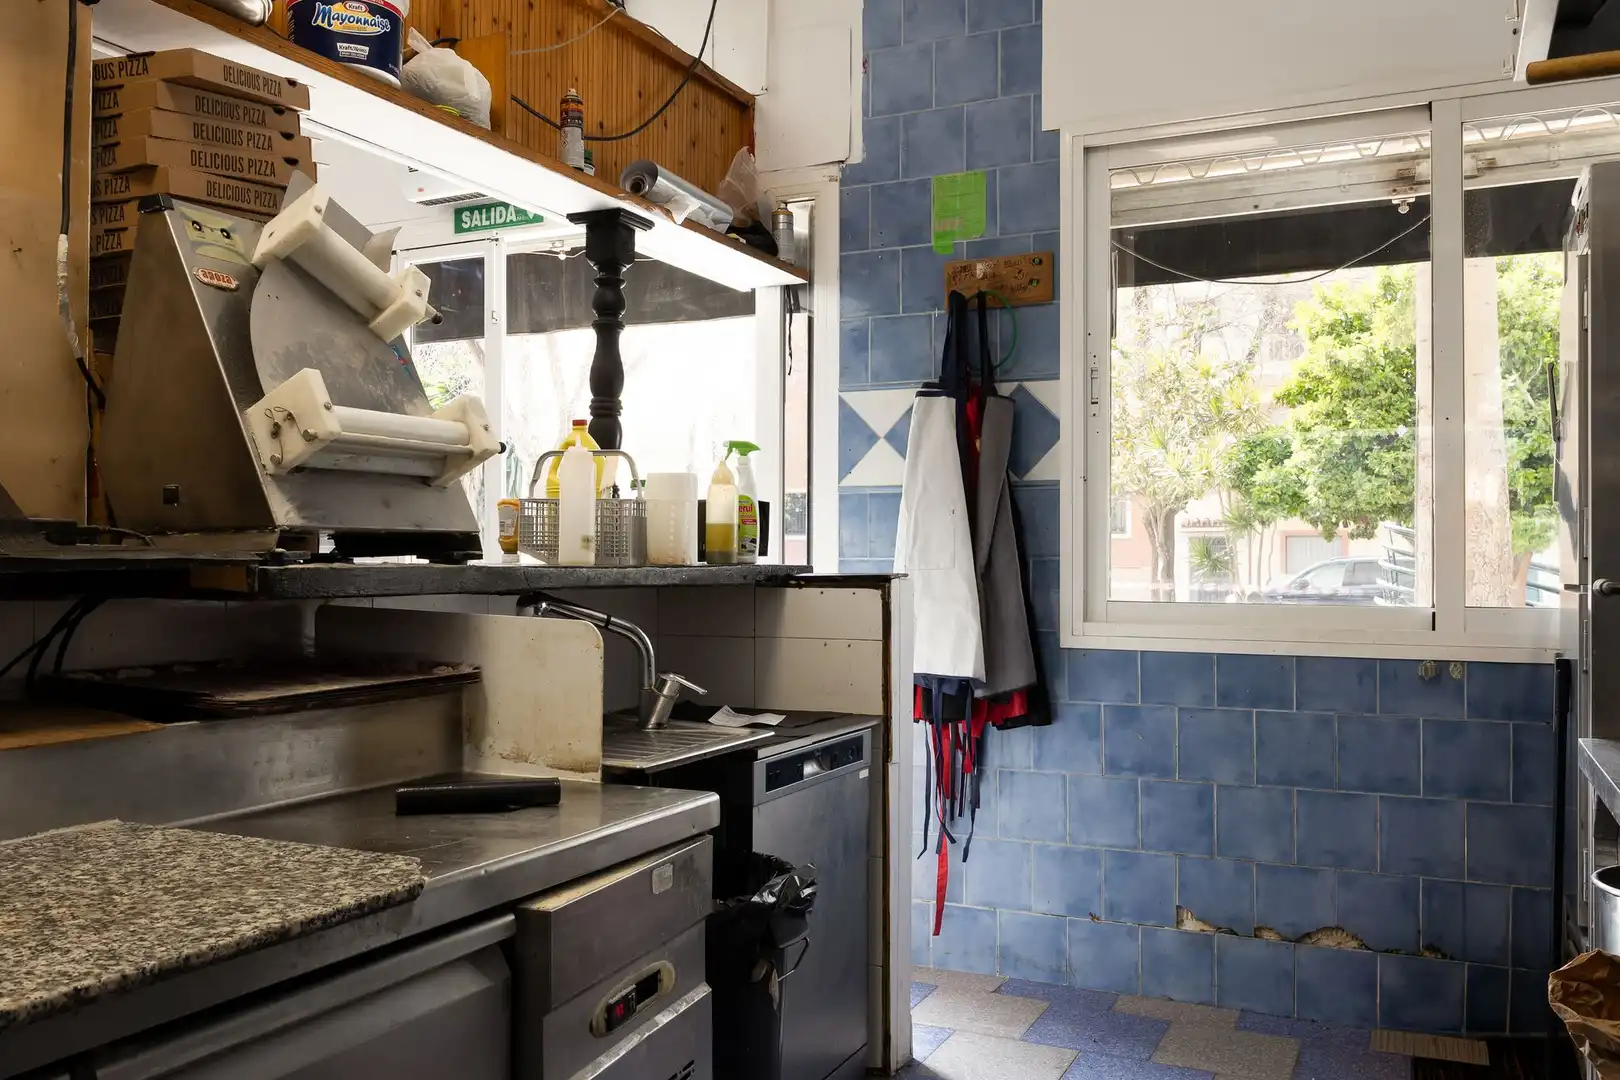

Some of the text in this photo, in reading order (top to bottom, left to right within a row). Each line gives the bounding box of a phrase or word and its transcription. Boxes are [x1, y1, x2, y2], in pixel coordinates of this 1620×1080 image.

[312, 2, 390, 31] Mayonnaise
[118, 57, 149, 78] PIZZA
[223, 64, 283, 98] DELICIOUS PIZZA
[98, 91, 119, 110] IZZA
[195, 95, 267, 127] DELICIOUS PIZZA
[193, 121, 273, 152] DELICIOUS PIZZA
[190, 149, 276, 178] DELICIOUS PIZZA
[104, 176, 131, 195] PIZZA
[206, 180, 278, 210] DELICIOUS PIZZA
[100, 206, 125, 225] PIZZA
[461, 205, 517, 229] SALIDA
[96, 233, 122, 252] PIZZA
